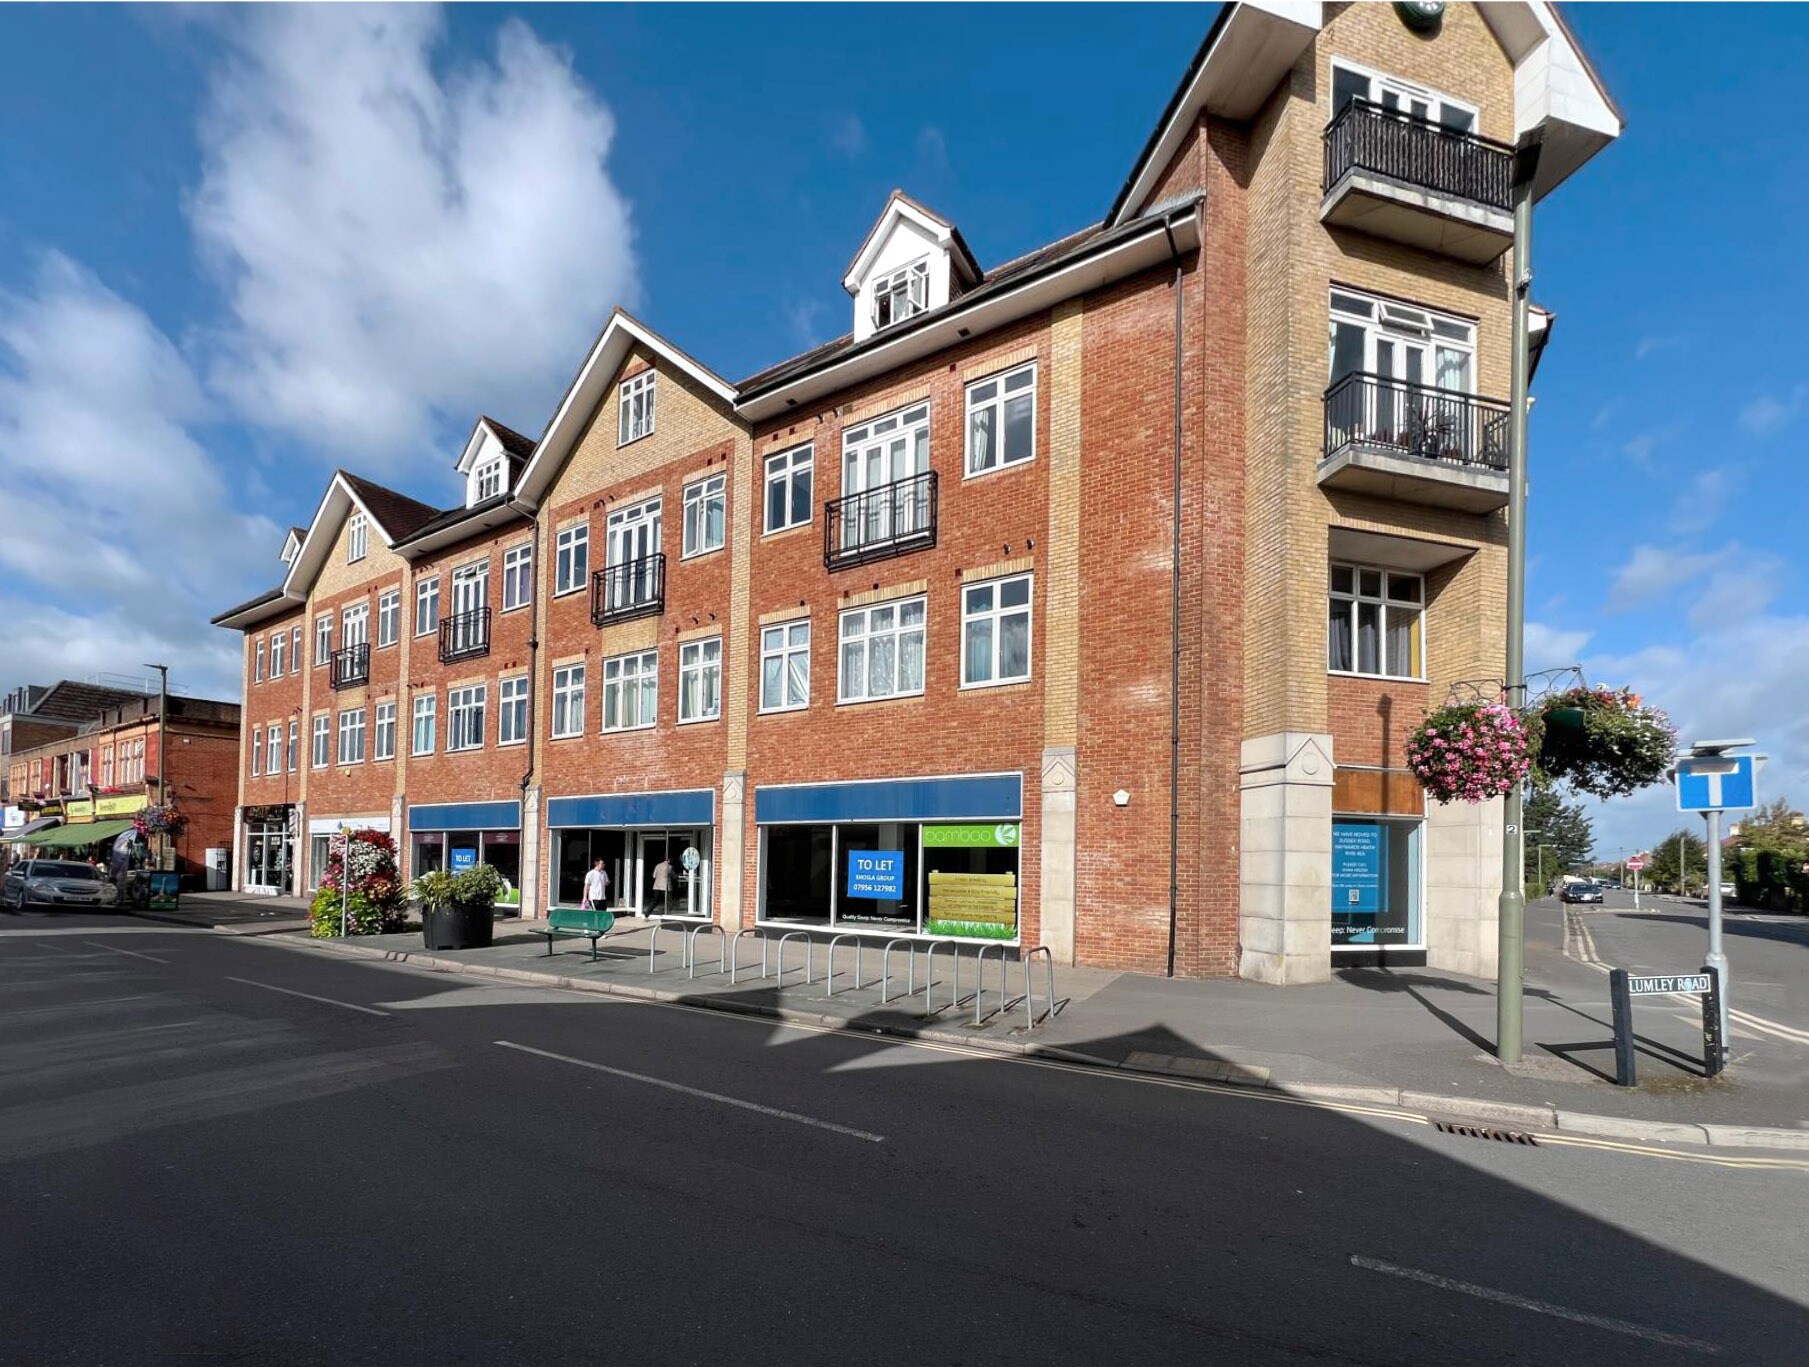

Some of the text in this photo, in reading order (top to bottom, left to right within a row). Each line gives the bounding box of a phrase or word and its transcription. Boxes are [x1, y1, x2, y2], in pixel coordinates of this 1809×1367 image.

[1507, 825, 1517, 835] 2
[857, 859, 894, 871] TO LET
[1346, 926, 1366, 934] Never
[1629, 977, 1707, 993] LUMLEY ROAD
